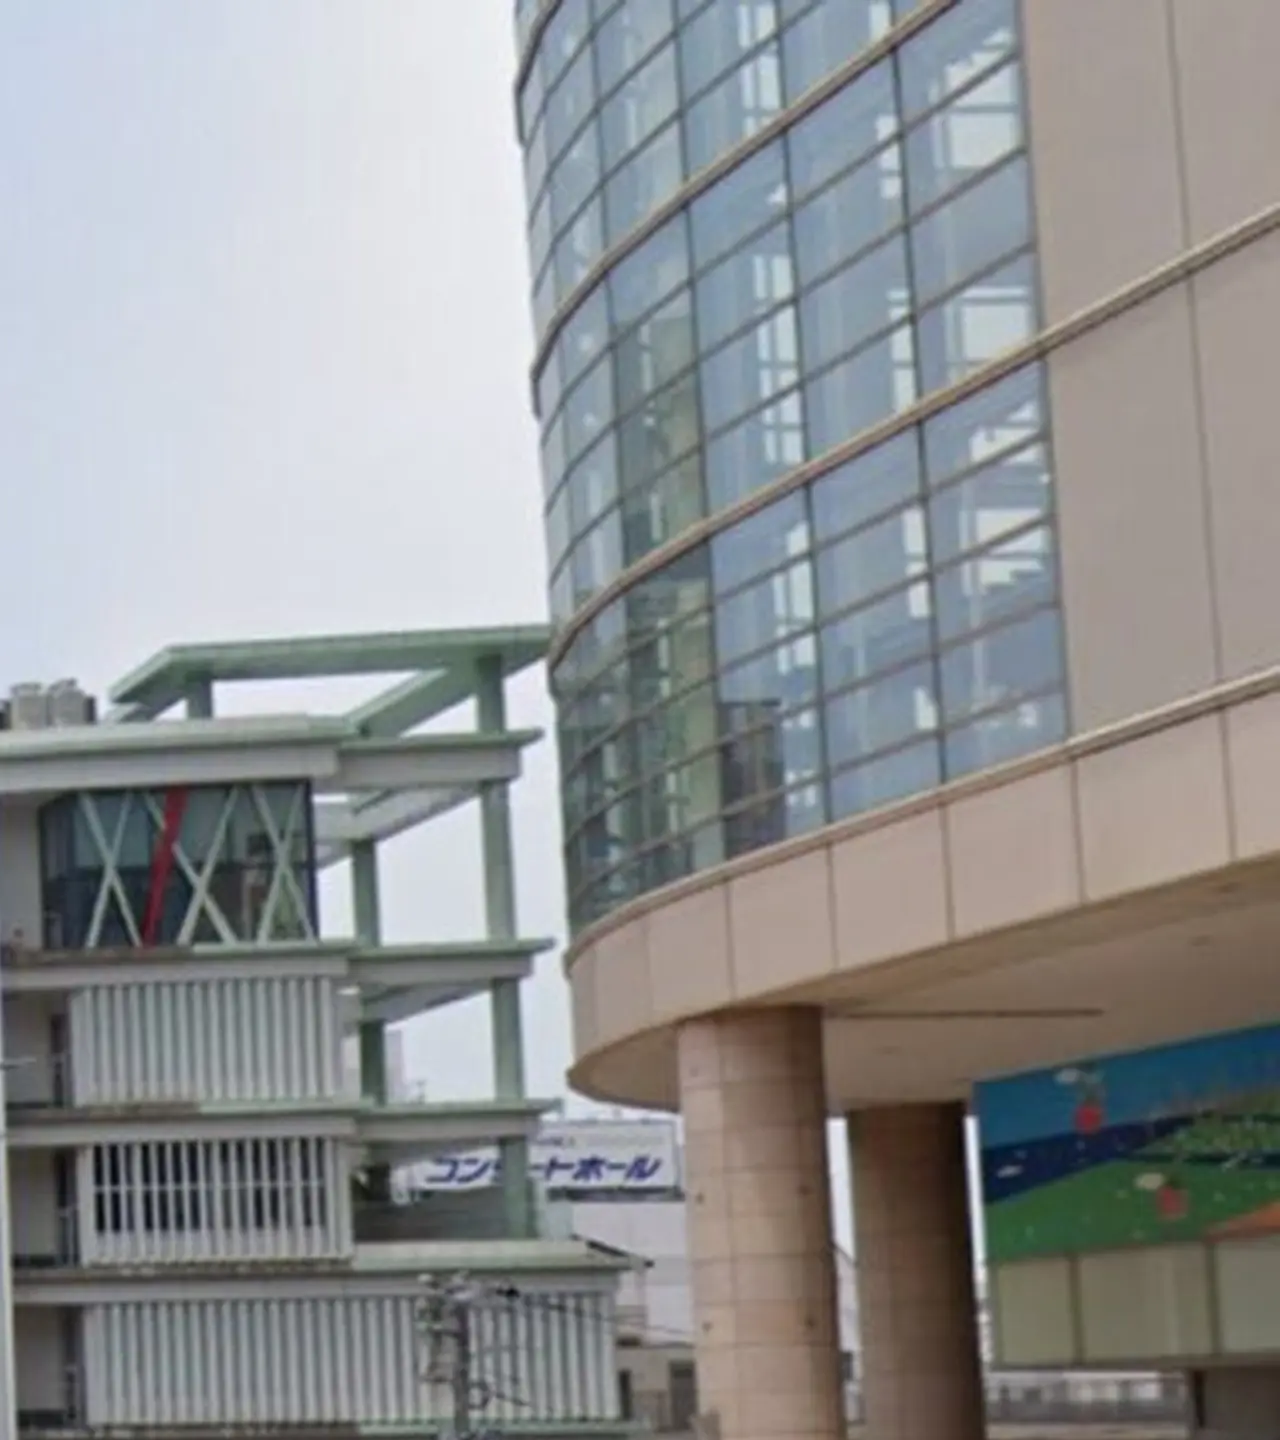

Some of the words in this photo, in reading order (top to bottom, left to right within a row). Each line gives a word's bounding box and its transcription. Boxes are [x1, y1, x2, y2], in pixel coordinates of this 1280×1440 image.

[425, 1155, 661, 1183] コンートホール
